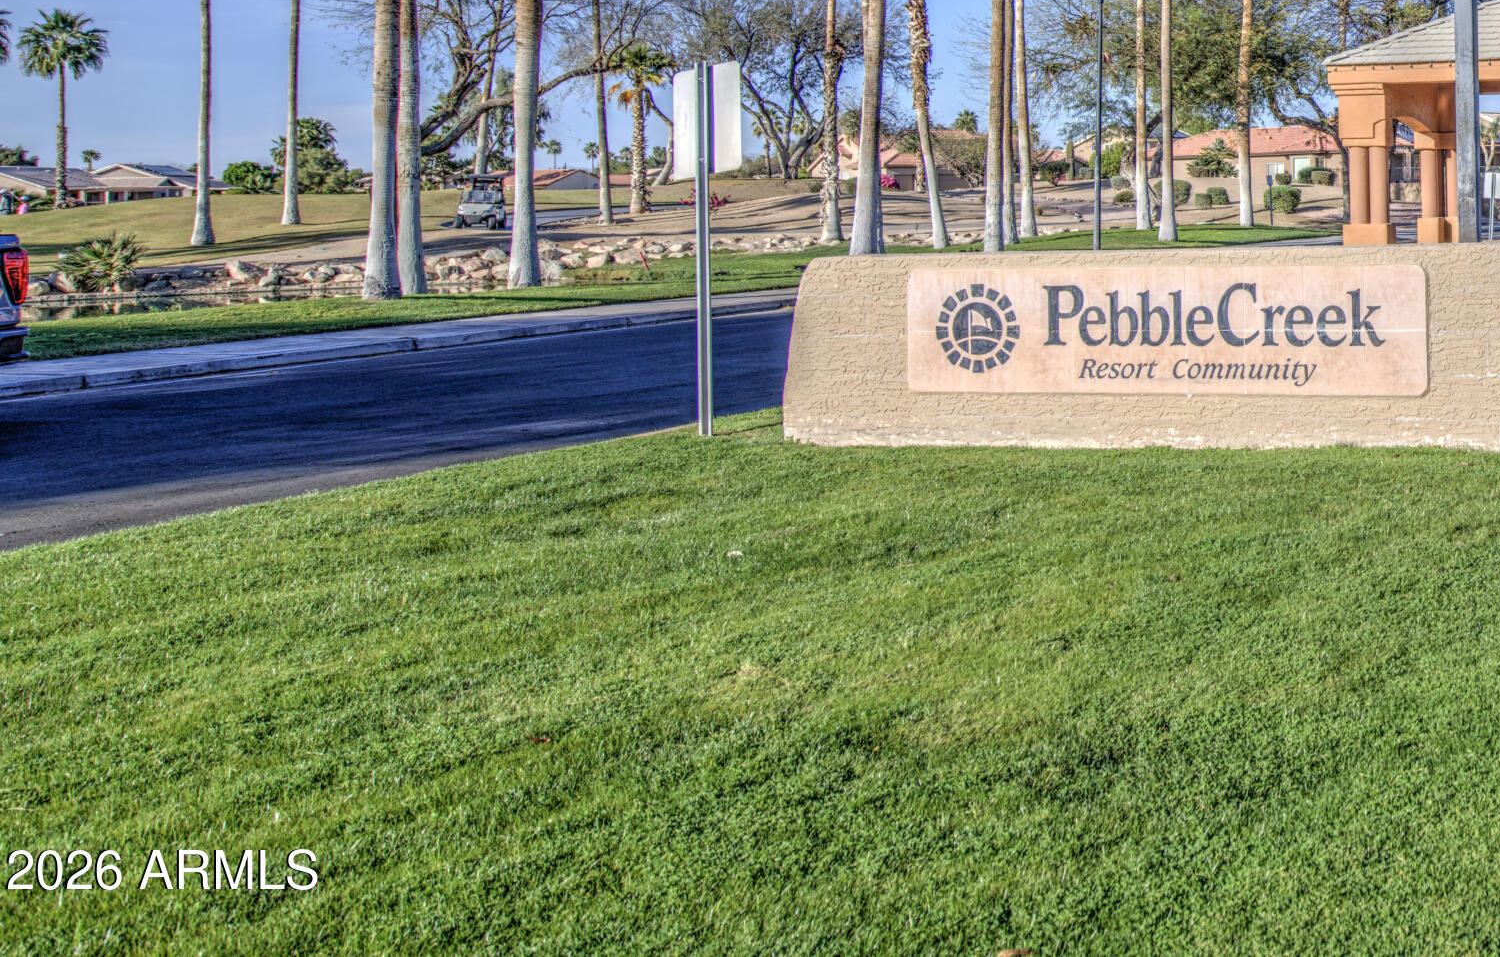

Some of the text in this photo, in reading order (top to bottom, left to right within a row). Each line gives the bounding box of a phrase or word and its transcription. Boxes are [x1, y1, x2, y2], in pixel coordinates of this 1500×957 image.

[1041, 282, 1387, 348] PebbleCreek
[1078, 358, 1317, 387] Resort Community
